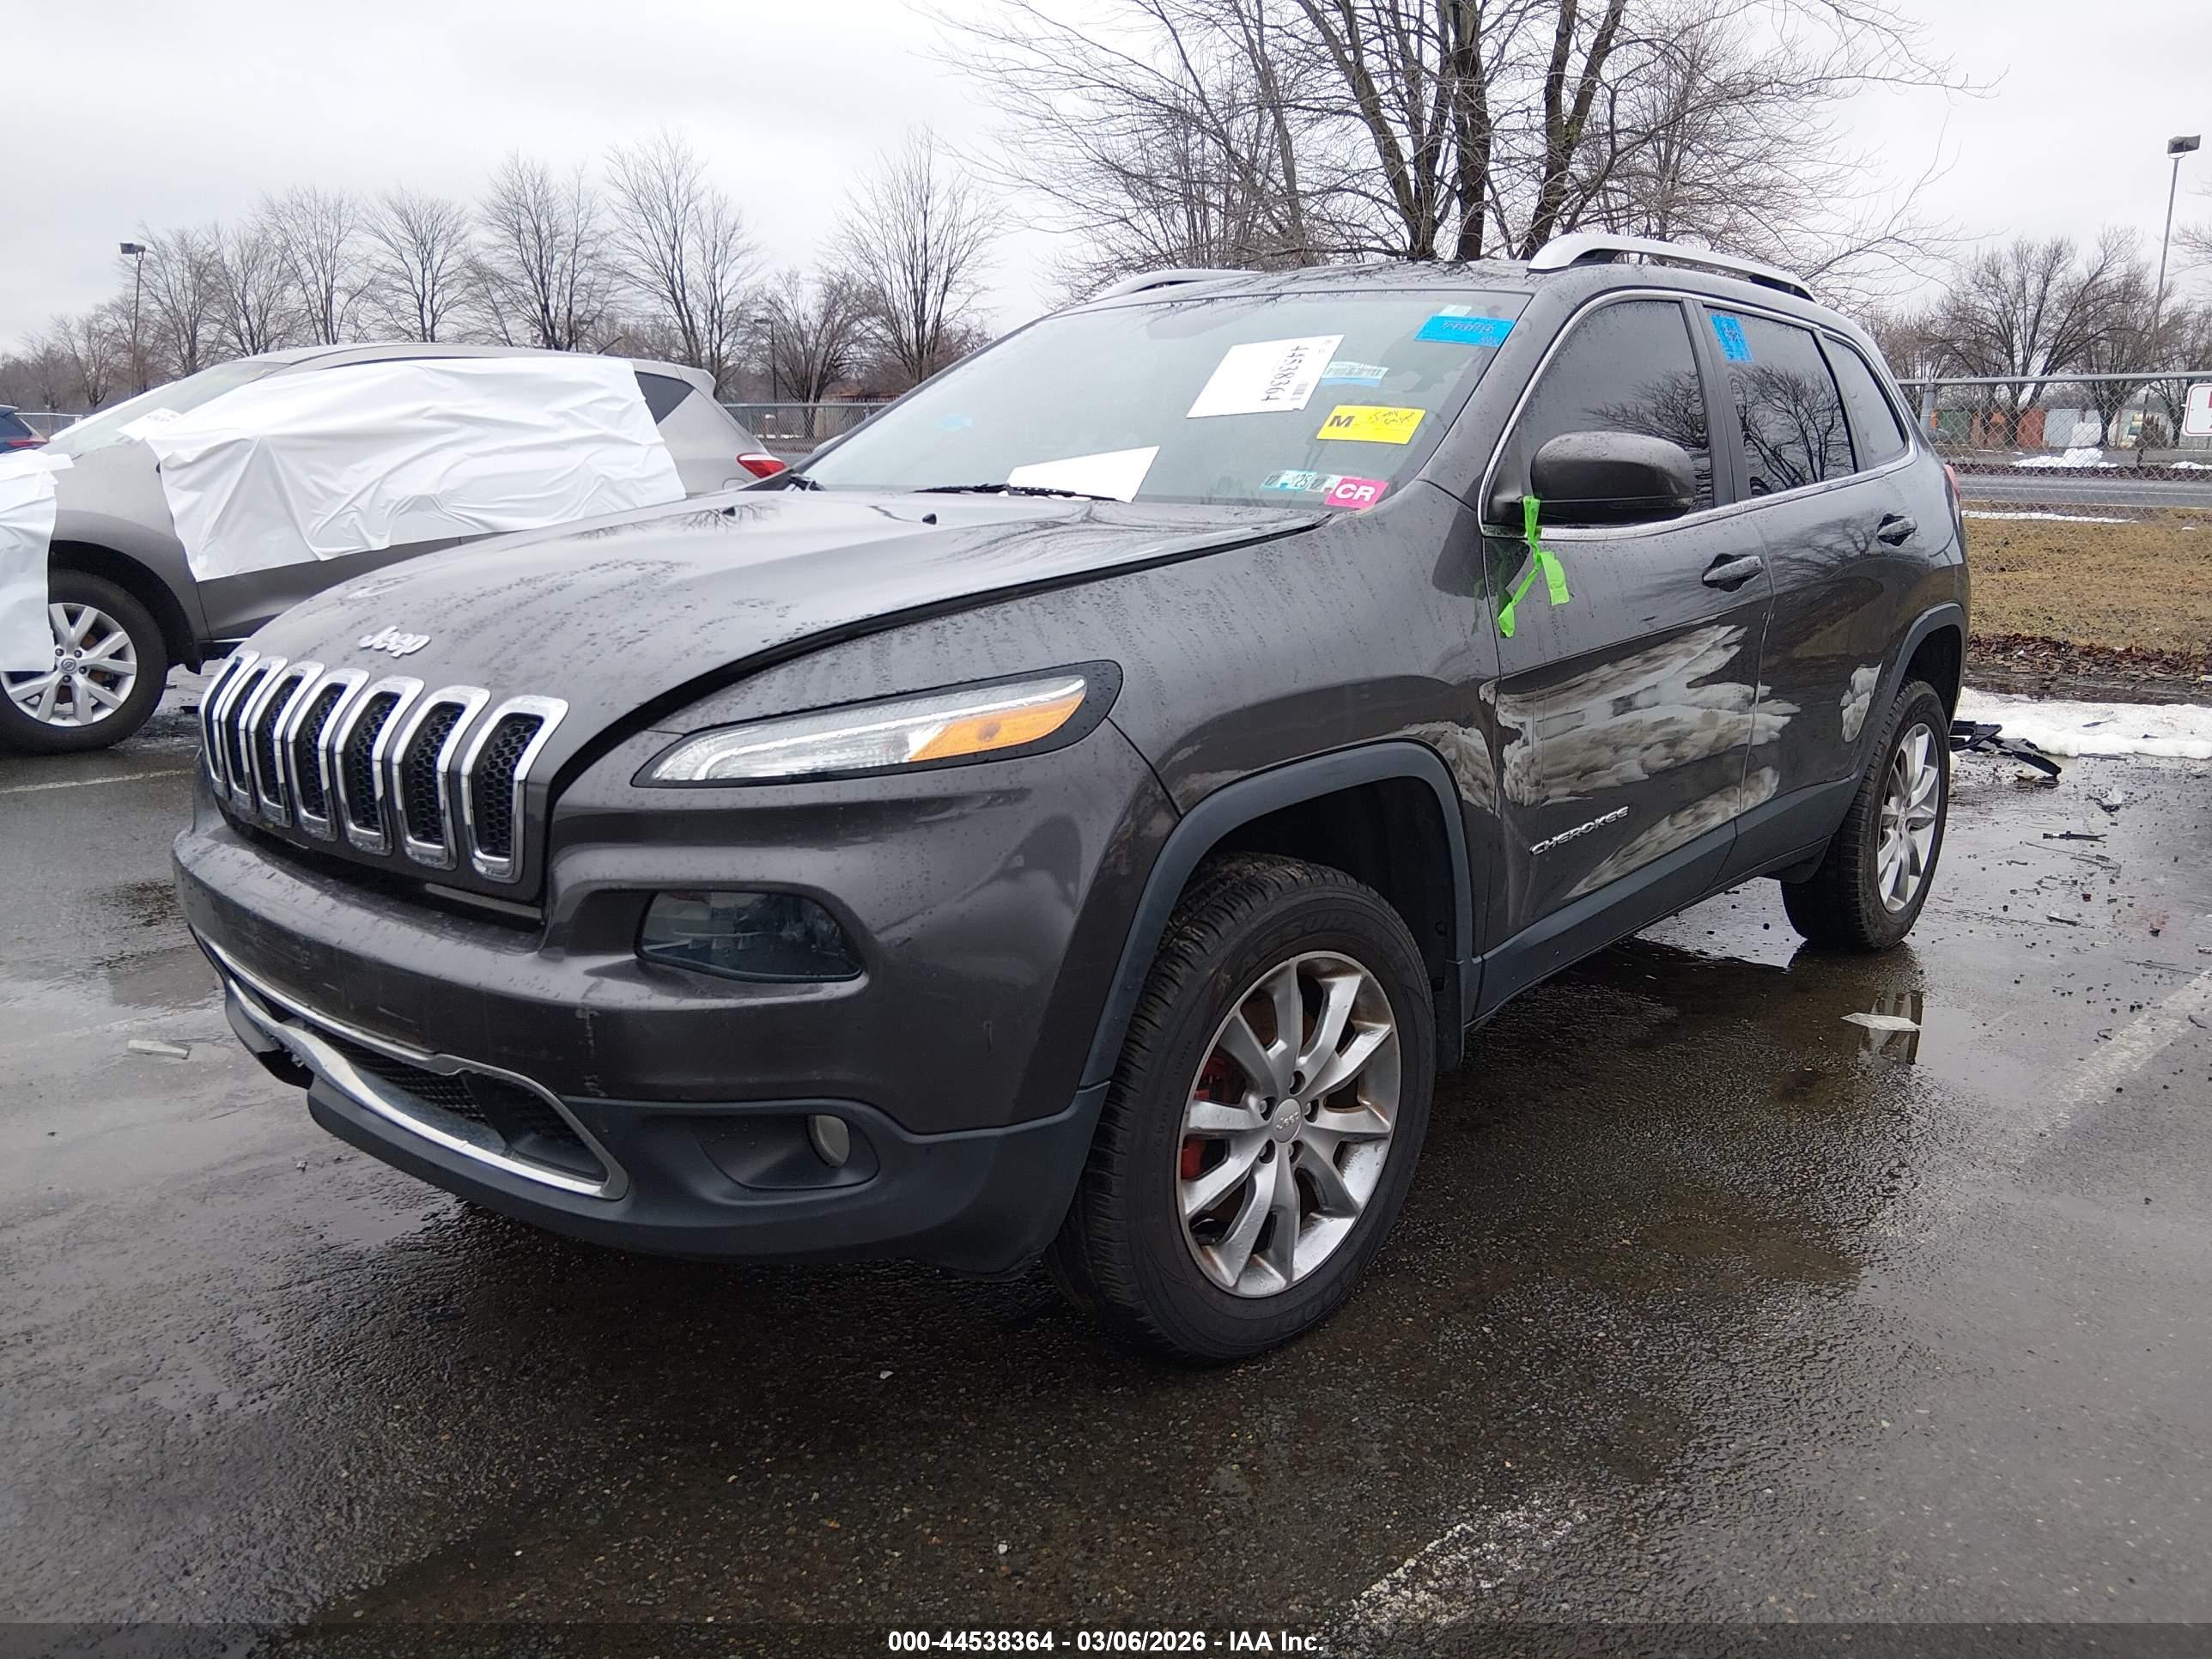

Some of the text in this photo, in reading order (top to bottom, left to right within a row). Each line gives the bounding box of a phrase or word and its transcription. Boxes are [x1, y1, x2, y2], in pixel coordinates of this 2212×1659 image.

[1261, 345, 1310, 402] 44538364
[1328, 415, 1355, 428] M
[1335, 483, 1376, 502] CR
[358, 625, 431, 659] Jeep
[1529, 805, 1629, 855] CHEROKEE
[1275, 1110, 1300, 1130] Jeep
